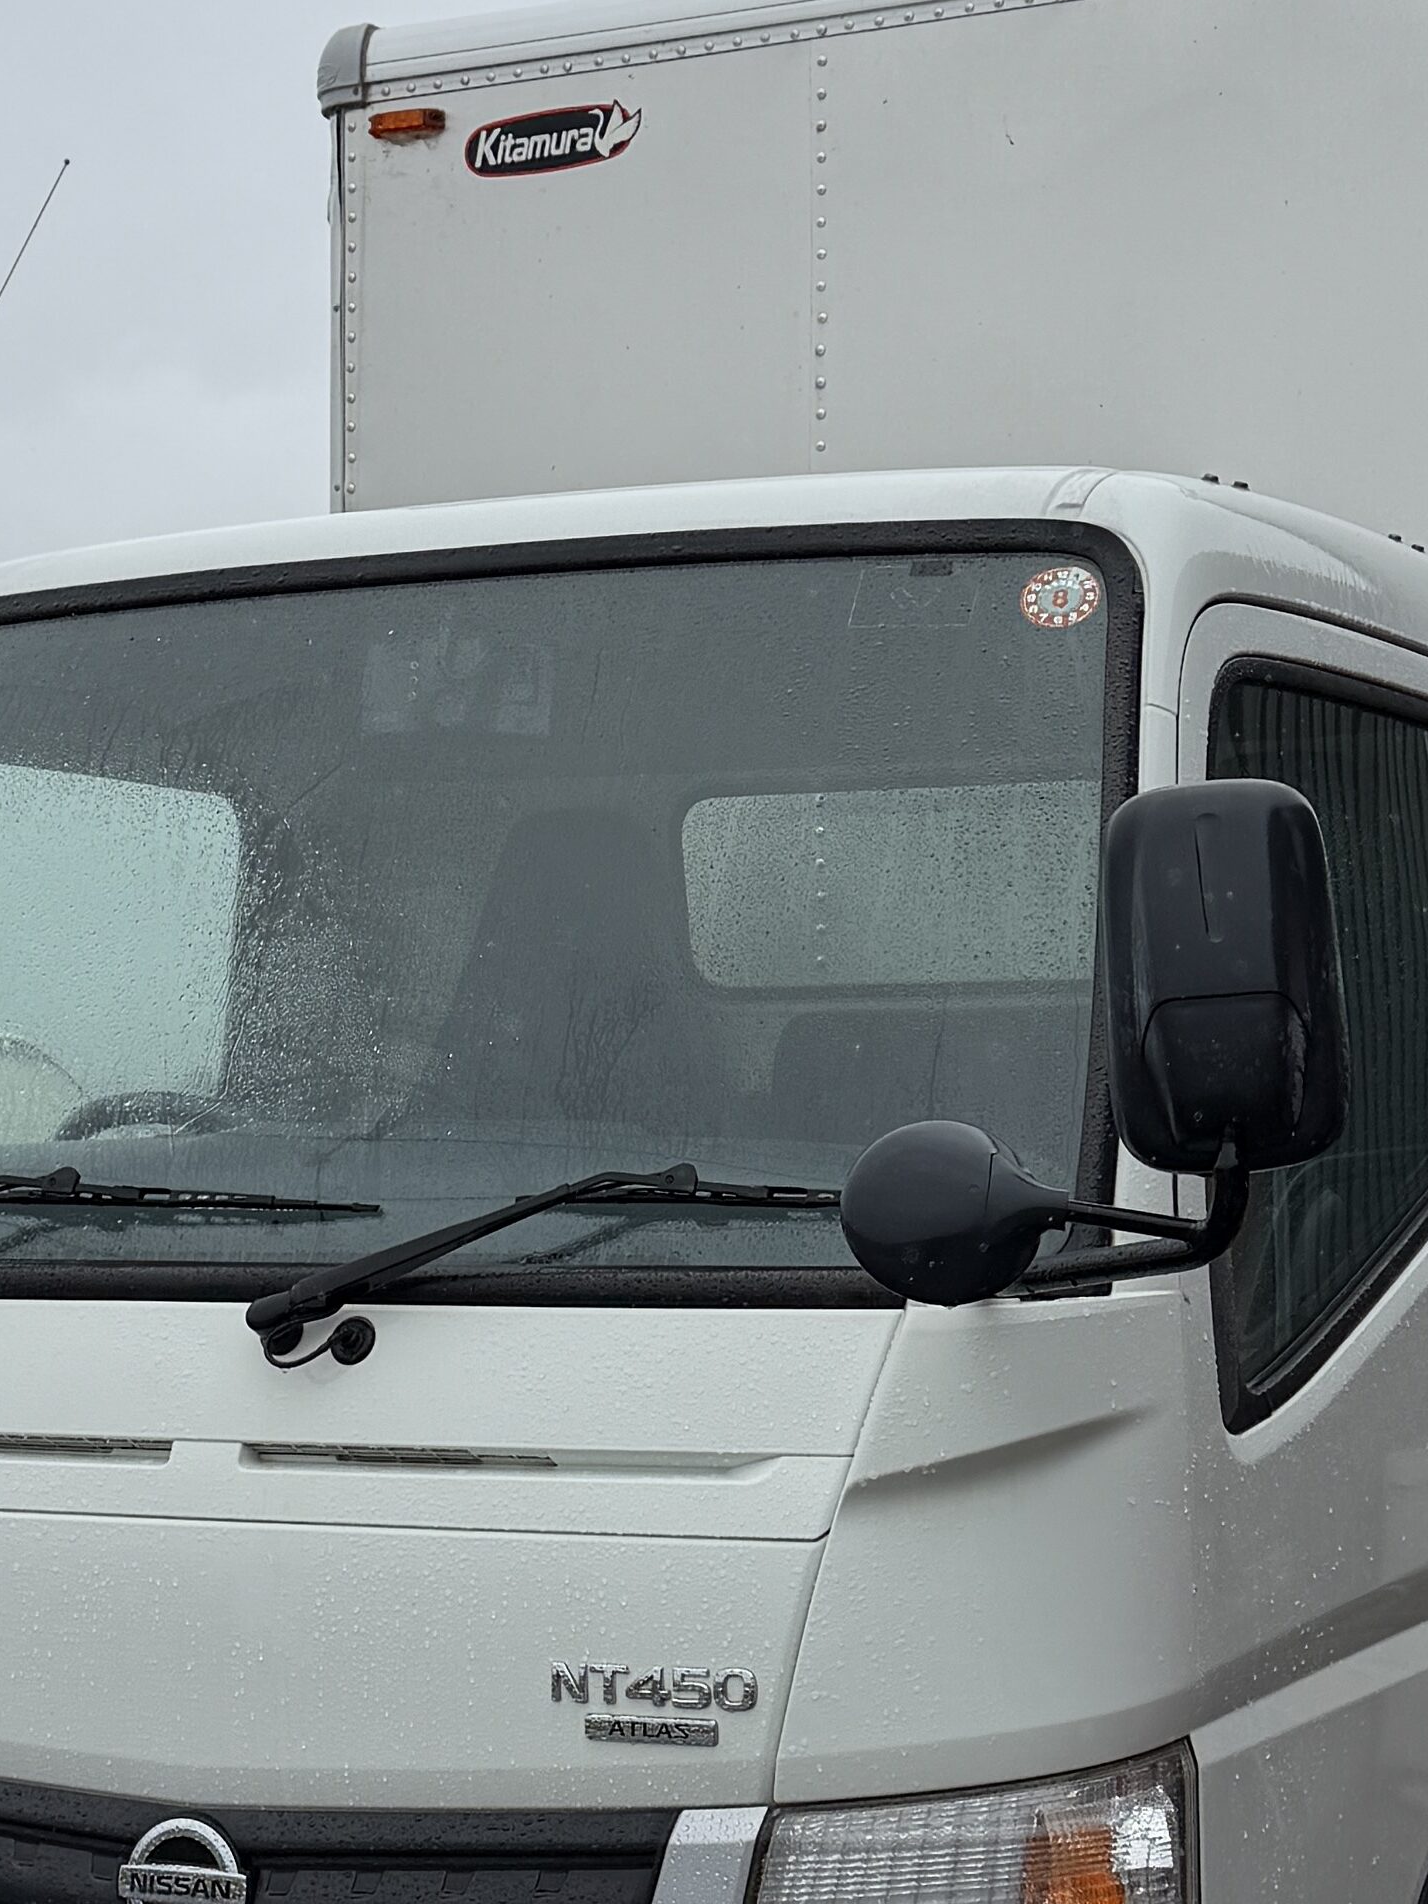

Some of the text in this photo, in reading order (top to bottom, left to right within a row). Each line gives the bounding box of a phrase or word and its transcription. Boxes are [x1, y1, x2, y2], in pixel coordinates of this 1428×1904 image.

[474, 127, 594, 168] Kitamura
[550, 1660, 759, 1713] NT450
[608, 1721, 690, 1740] ATLAS
[129, 1872, 232, 1900] NISSAN
